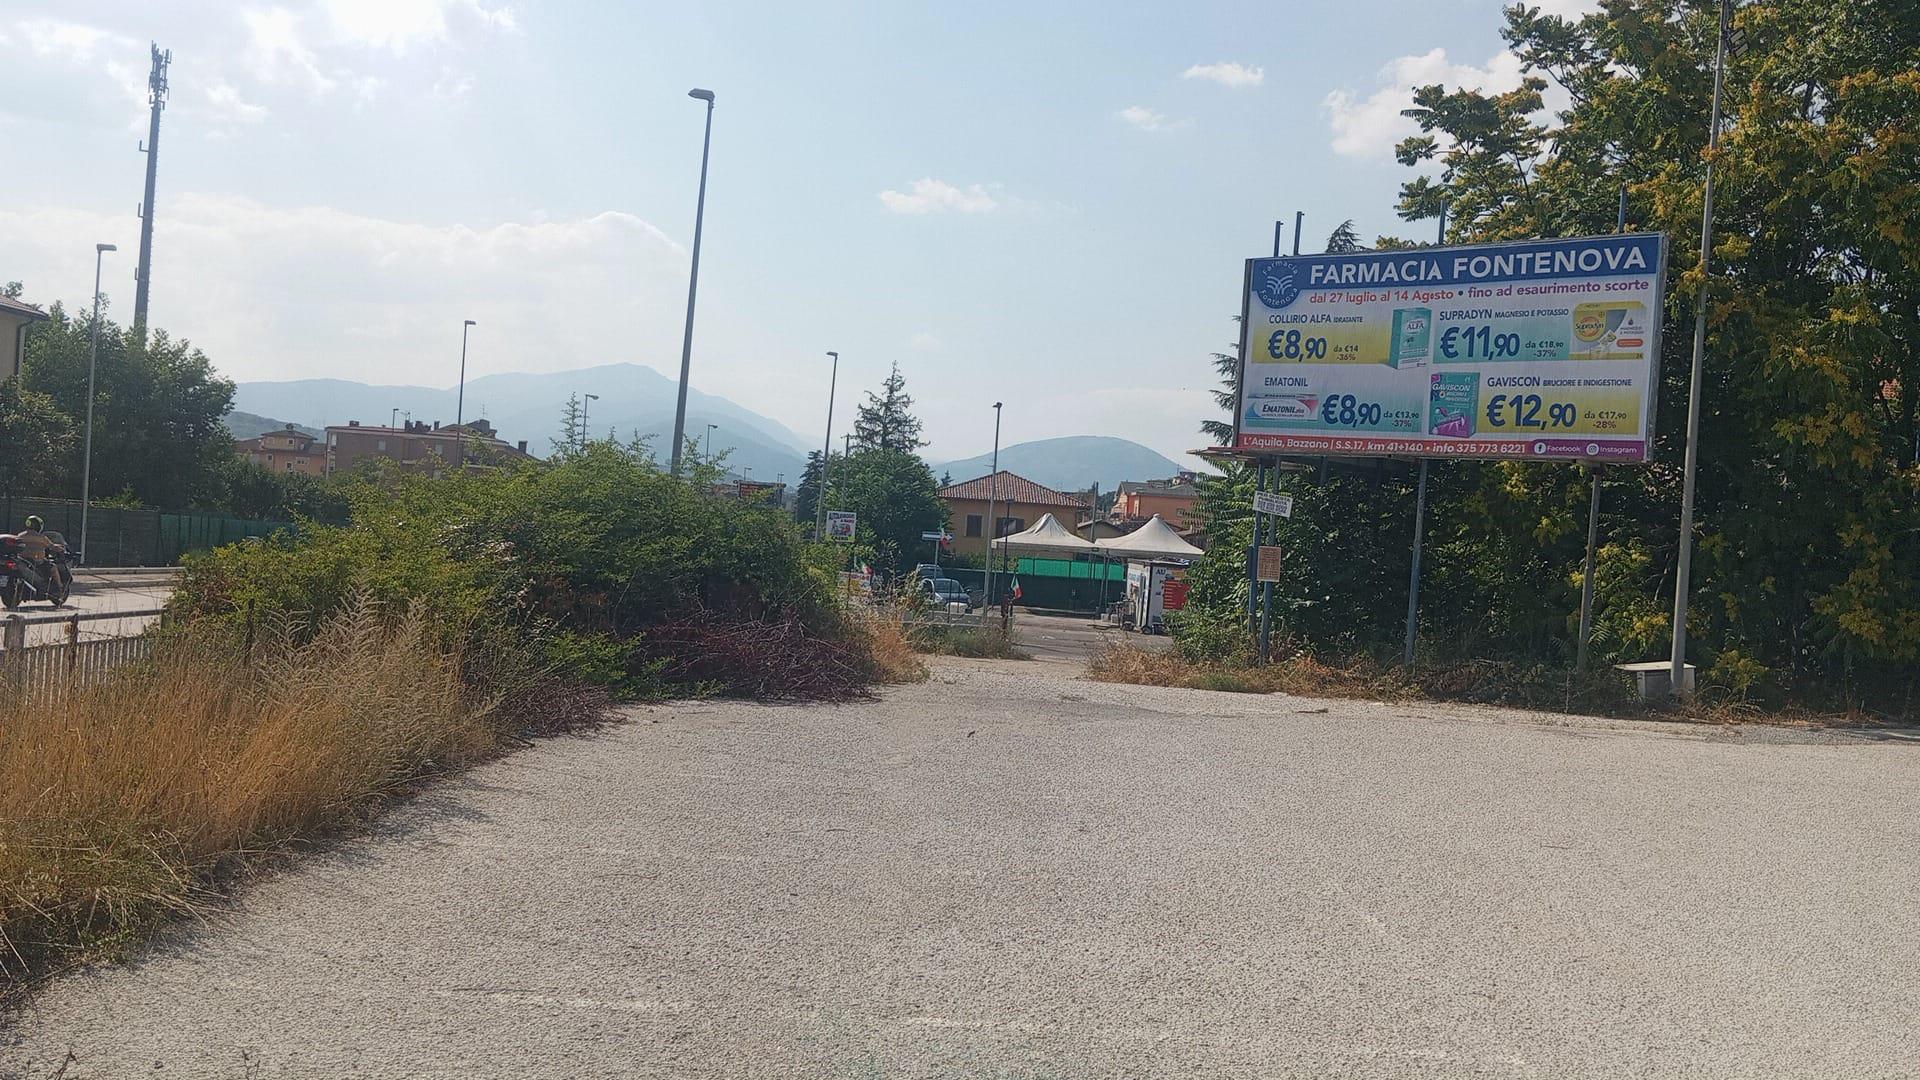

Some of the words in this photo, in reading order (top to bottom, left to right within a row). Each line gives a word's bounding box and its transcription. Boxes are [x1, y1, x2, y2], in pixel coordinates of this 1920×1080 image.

[1262, 260, 1298, 276] Farmacia
[1310, 259, 1442, 285] FARMACIA
[1453, 246, 1647, 279] FONTENOVA
[1260, 287, 1298, 306] Fontenova
[1310, 292, 1327, 304] dal
[1330, 292, 1344, 303] 27
[1346, 291, 1377, 306] luglio
[1380, 290, 1391, 302] al
[1394, 290, 1409, 301] 14
[1412, 290, 1454, 304] Agosto
[1468, 285, 1493, 298] fino
[1496, 284, 1513, 297] ad
[1517, 281, 1601, 296] esaurimento
[1605, 278, 1649, 292] scorte
[1269, 314, 1308, 325] COLLIRIO
[1309, 313, 1331, 324] ALFA
[1439, 309, 1493, 321] SUPRADYN
[1494, 310, 1530, 318] MAGNESIO
[1530, 310, 1536, 318] E
[1537, 308, 1569, 318] POTASSIO
[1268, 329, 1328, 362] €8,90
[1333, 345, 1343, 353] da
[1344, 345, 1359, 353] €14
[1440, 325, 1521, 361] €11,90
[1525, 340, 1537, 349] da
[1533, 349, 1557, 358] -37%
[1264, 377, 1309, 387] EMATONIL
[1487, 376, 1540, 388] GAVISCON
[1543, 379, 1577, 387] BRUCIORE
[1577, 379, 1582, 387] E
[1583, 378, 1633, 387] INDIGESTIONE
[1323, 394, 1381, 428] €8,90
[1383, 410, 1393, 419] da
[1487, 394, 1577, 431] €12,90
[1584, 411, 1596, 420] da
[1391, 419, 1412, 428] -37%
[1592, 420, 1617, 429] -28%
[1244, 437, 1285, 449] L'Aquila,
[1287, 438, 1329, 449] Bazzano
[1367, 441, 1385, 451] km
[1386, 441, 1423, 451] 41+140
[1432, 442, 1455, 453] info
[1456, 443, 1477, 453] 375
[1479, 443, 1498, 453] 773
[1501, 444, 1525, 454] 6221
[1547, 445, 1581, 453] Facebook
[1600, 446, 1637, 455] Instagram
